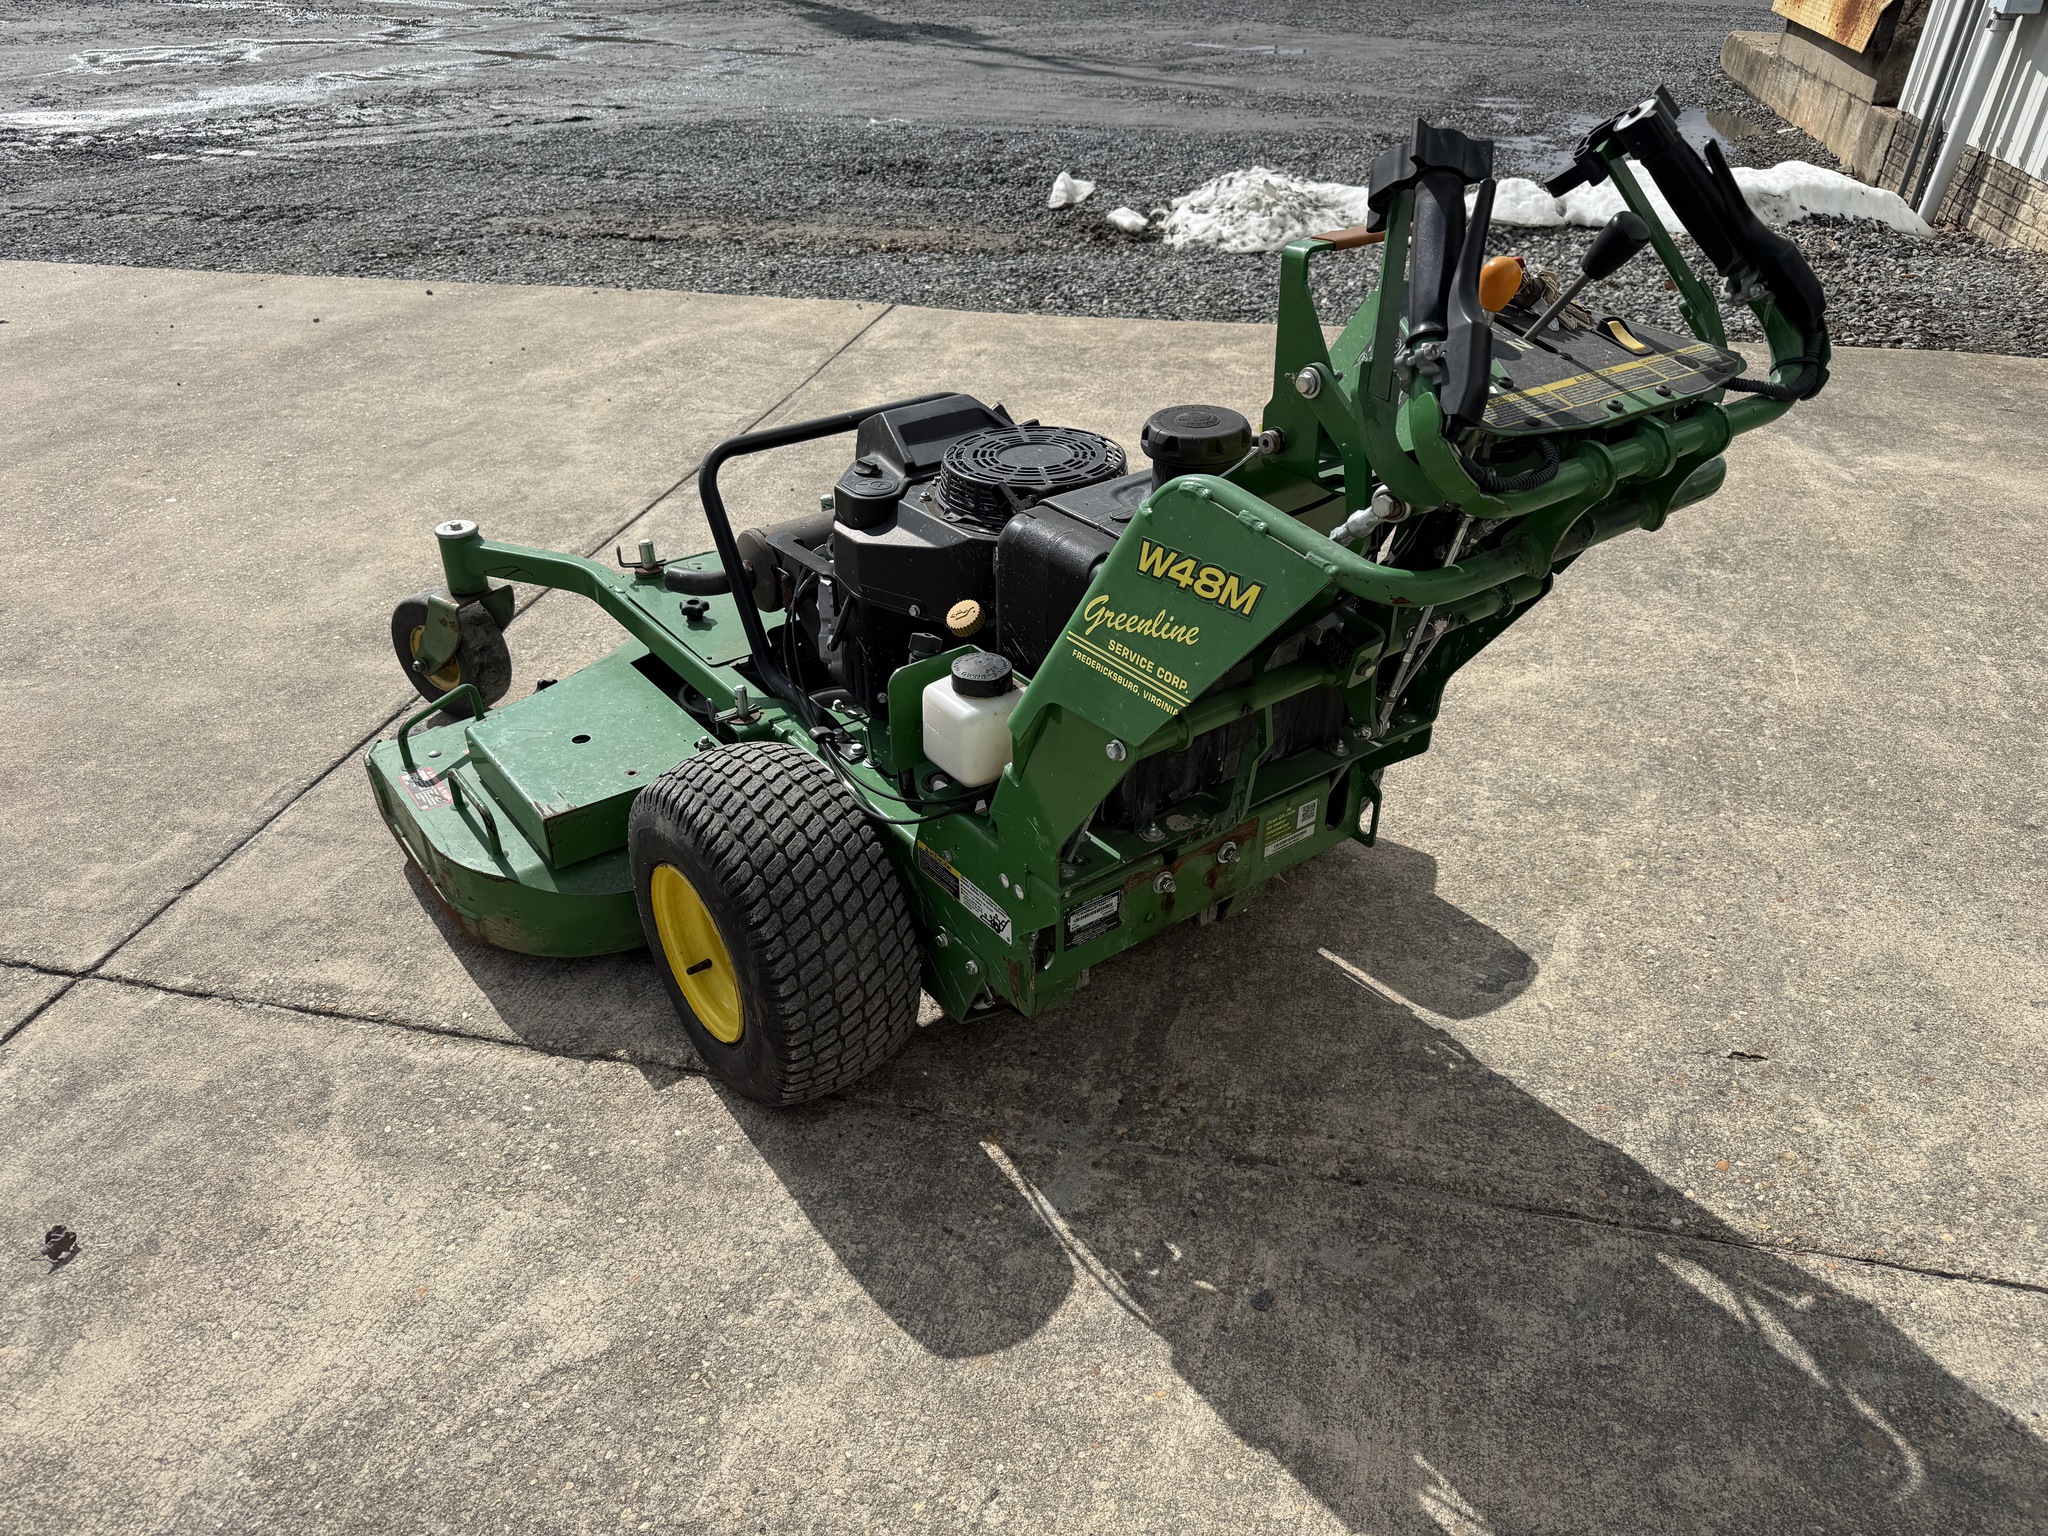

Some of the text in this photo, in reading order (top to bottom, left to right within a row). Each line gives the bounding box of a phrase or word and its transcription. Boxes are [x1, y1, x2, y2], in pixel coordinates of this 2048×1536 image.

[1137, 538, 1264, 618] W48M
[1083, 594, 1200, 645] Greenline
[1071, 648, 1180, 716] FREDERICKSBURG, VIRGINIA
[1108, 639, 1189, 694] SERVICE CORP.
